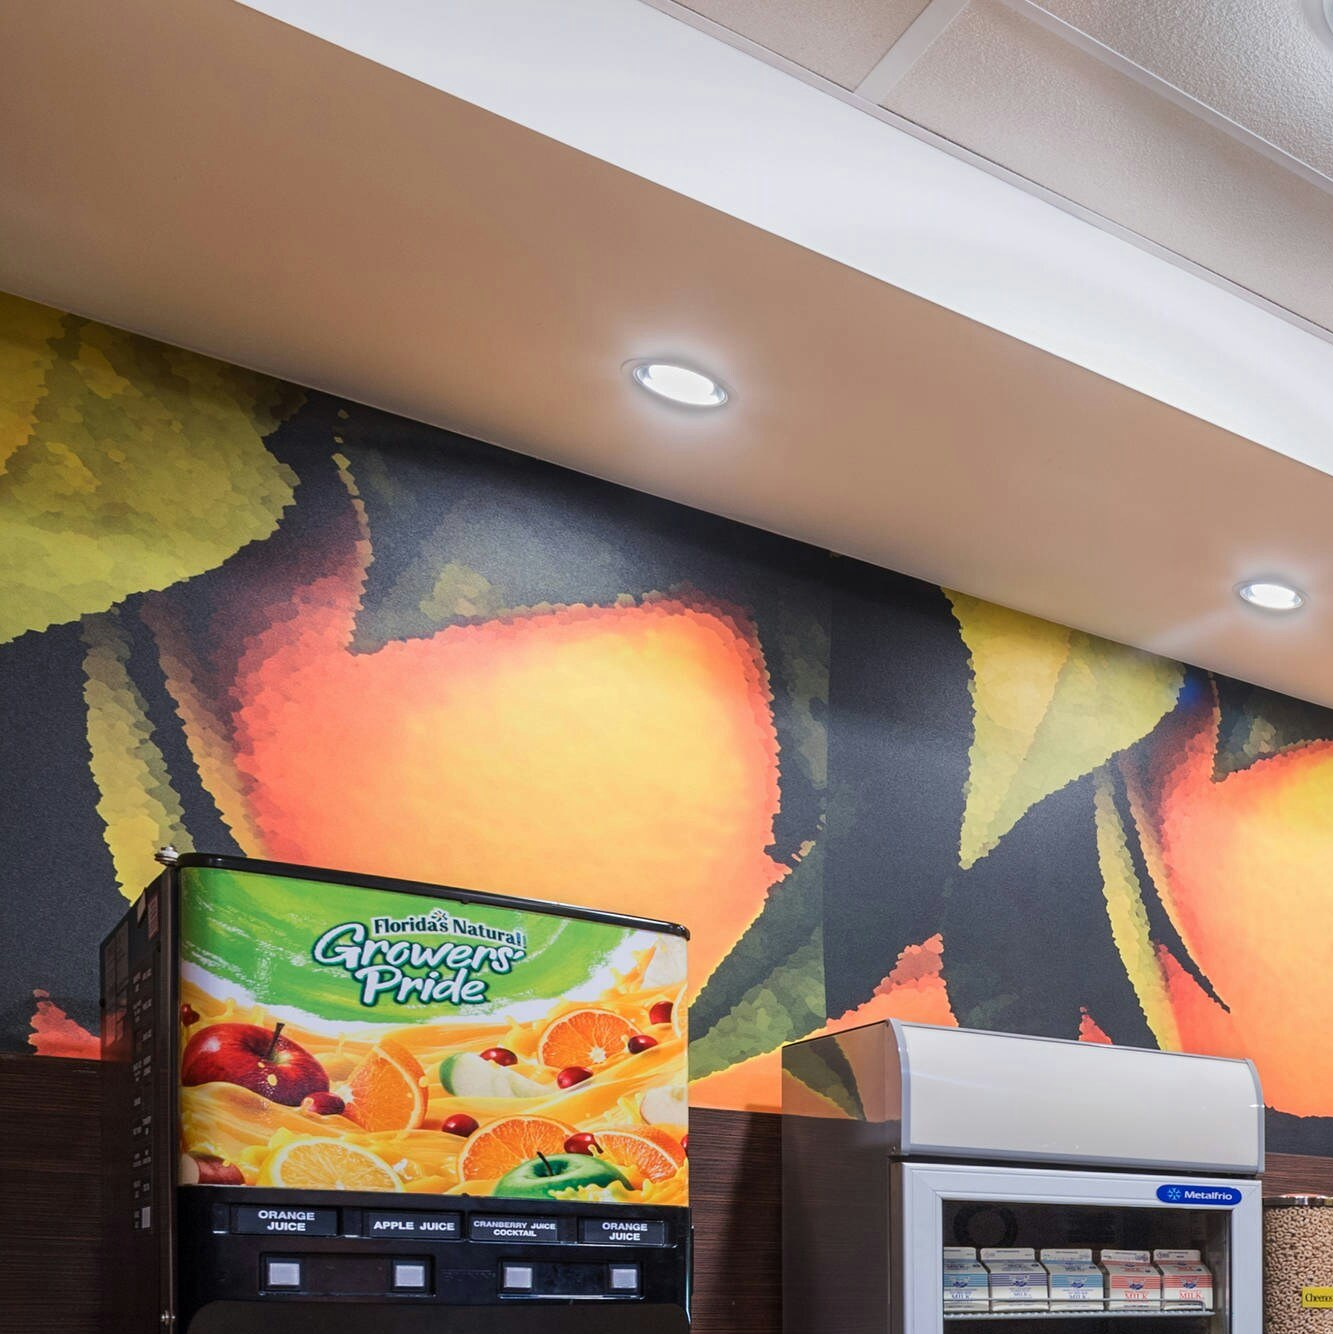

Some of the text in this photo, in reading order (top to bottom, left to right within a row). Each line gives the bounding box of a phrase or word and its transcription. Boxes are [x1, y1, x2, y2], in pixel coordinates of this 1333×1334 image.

[353, 964, 489, 1006] Pride
[1184, 1190, 1233, 1200] Metalfrio
[258, 1210, 315, 1221] ORANGE
[267, 1221, 306, 1231] JUICE
[373, 1221, 455, 1231] APPLE JUICE
[473, 1220, 556, 1230] CRANBERRY JUICE
[602, 1222, 648, 1232] ORANGE
[493, 1229, 537, 1237] COCKTAIL
[609, 1232, 640, 1241] JUICE
